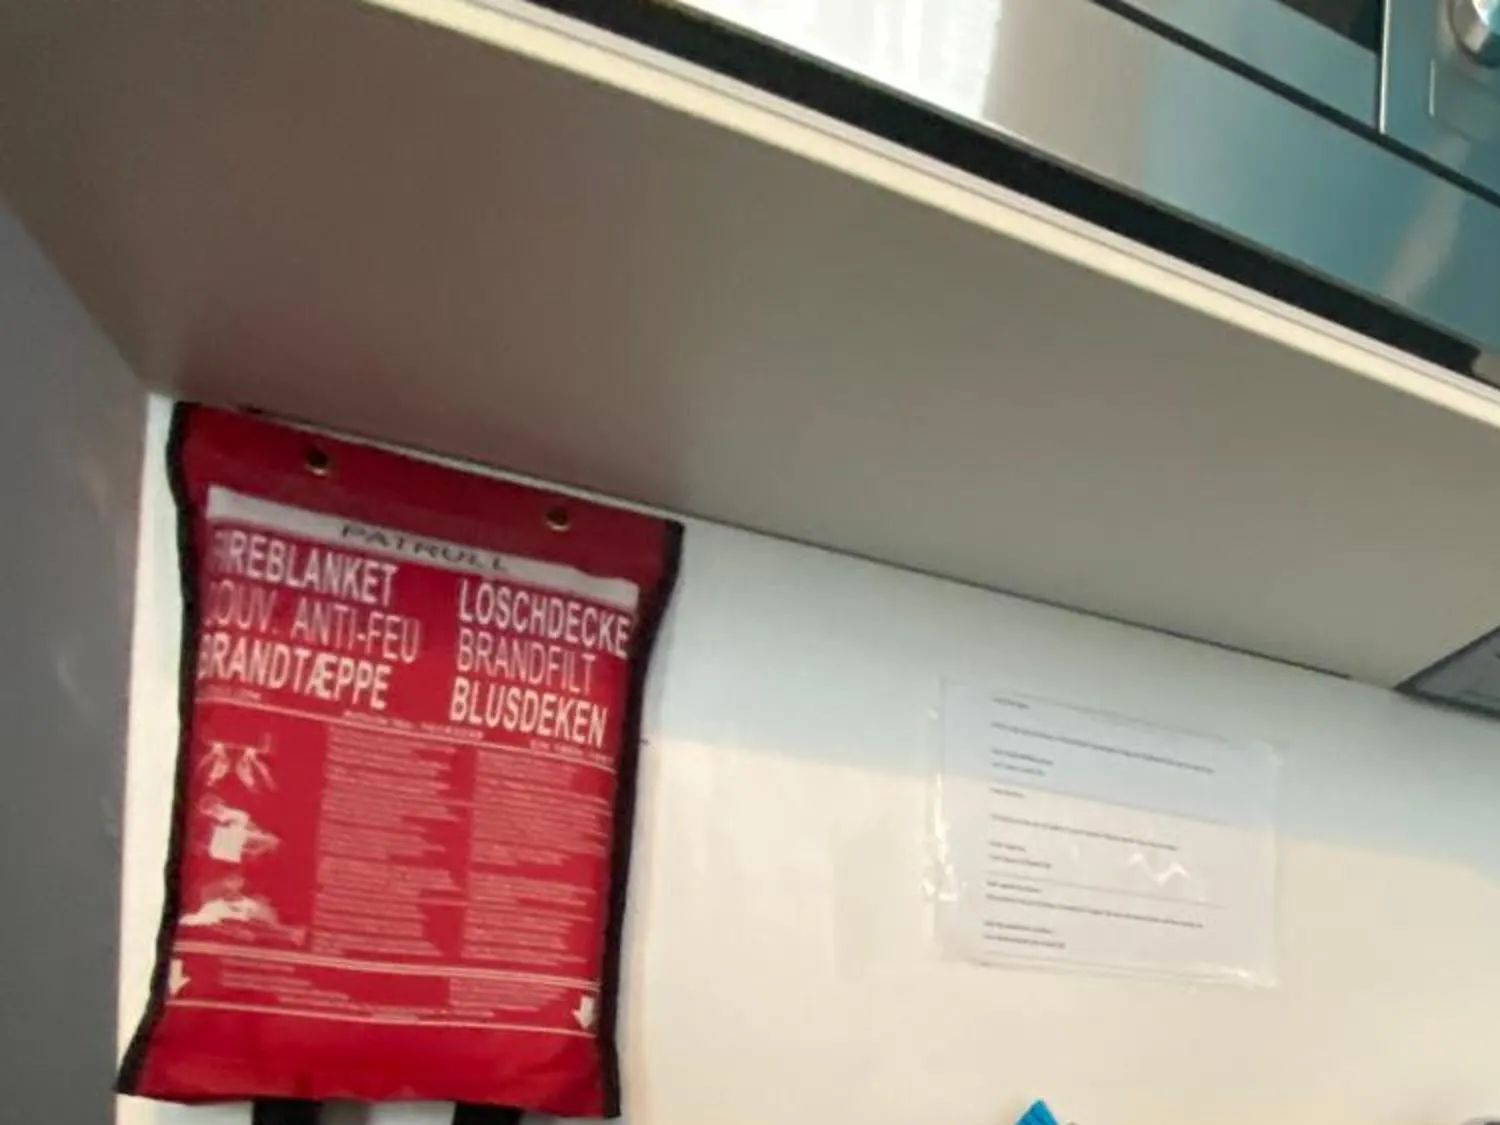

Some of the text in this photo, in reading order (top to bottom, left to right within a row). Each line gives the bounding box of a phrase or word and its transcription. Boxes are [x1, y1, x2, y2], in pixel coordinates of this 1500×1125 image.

[290, 597, 421, 664] ANTI-FEU
[457, 627, 597, 695] BRANDFILT
[450, 676, 608, 748] BLUSDEKEN
